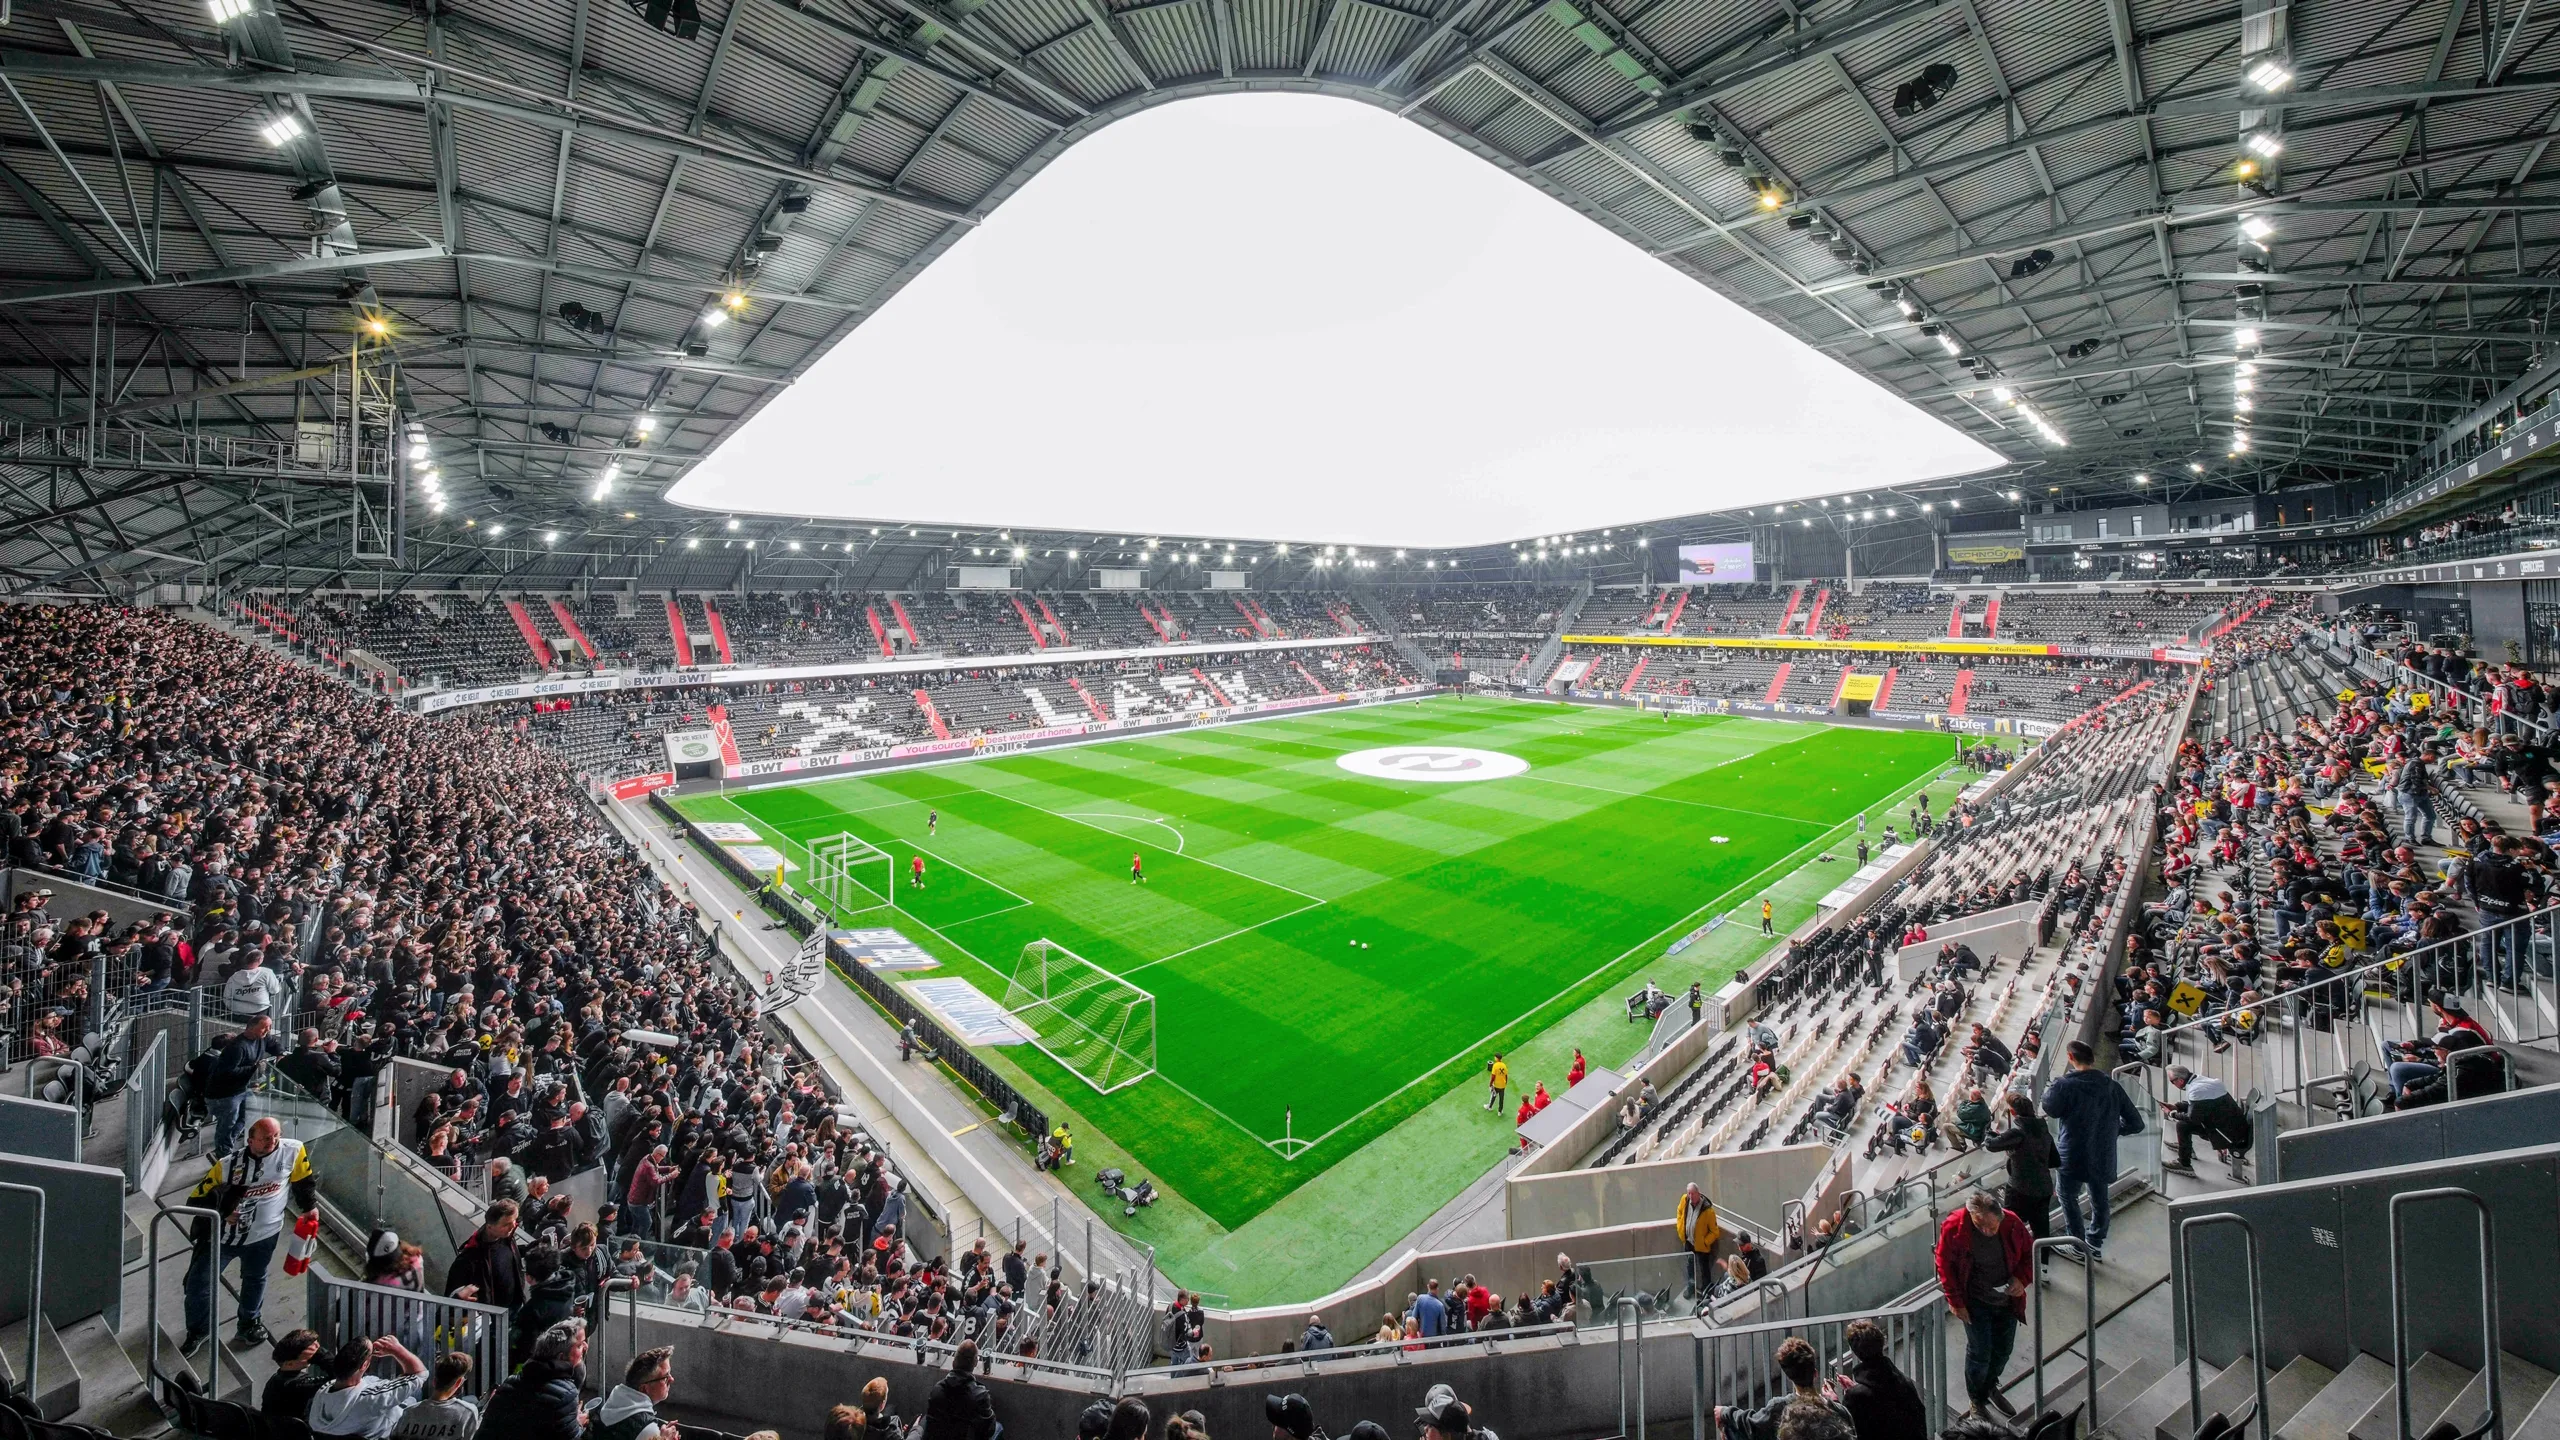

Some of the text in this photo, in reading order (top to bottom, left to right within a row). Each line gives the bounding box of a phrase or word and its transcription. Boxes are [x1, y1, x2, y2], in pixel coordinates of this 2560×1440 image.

[2100, 648, 2153, 657] SALZKAMMERGUT
[634, 676, 663, 686] BWT
[679, 674, 707, 683] BWT
[597, 680, 612, 688] KELIT
[505, 688, 519, 696] KELIT
[1244, 705, 1258, 713] BWT
[1123, 719, 1141, 729] BWT
[1156, 715, 1173, 724] BWT
[1947, 717, 1987, 730] Zipfer
[1088, 723, 1107, 732] BWT
[906, 744, 929, 754] Your
[932, 740, 967, 751] source
[986, 734, 1007, 744] best
[1009, 732, 1035, 742] water
[1037, 731, 1047, 739] at
[1048, 727, 1072, 738] home
[863, 749, 892, 761] BWT
[810, 755, 839, 767] BWT
[751, 762, 783, 774] BWT
[511, 1140, 532, 1154] Zipfer
[402, 1423, 456, 1437] ADIDAS
